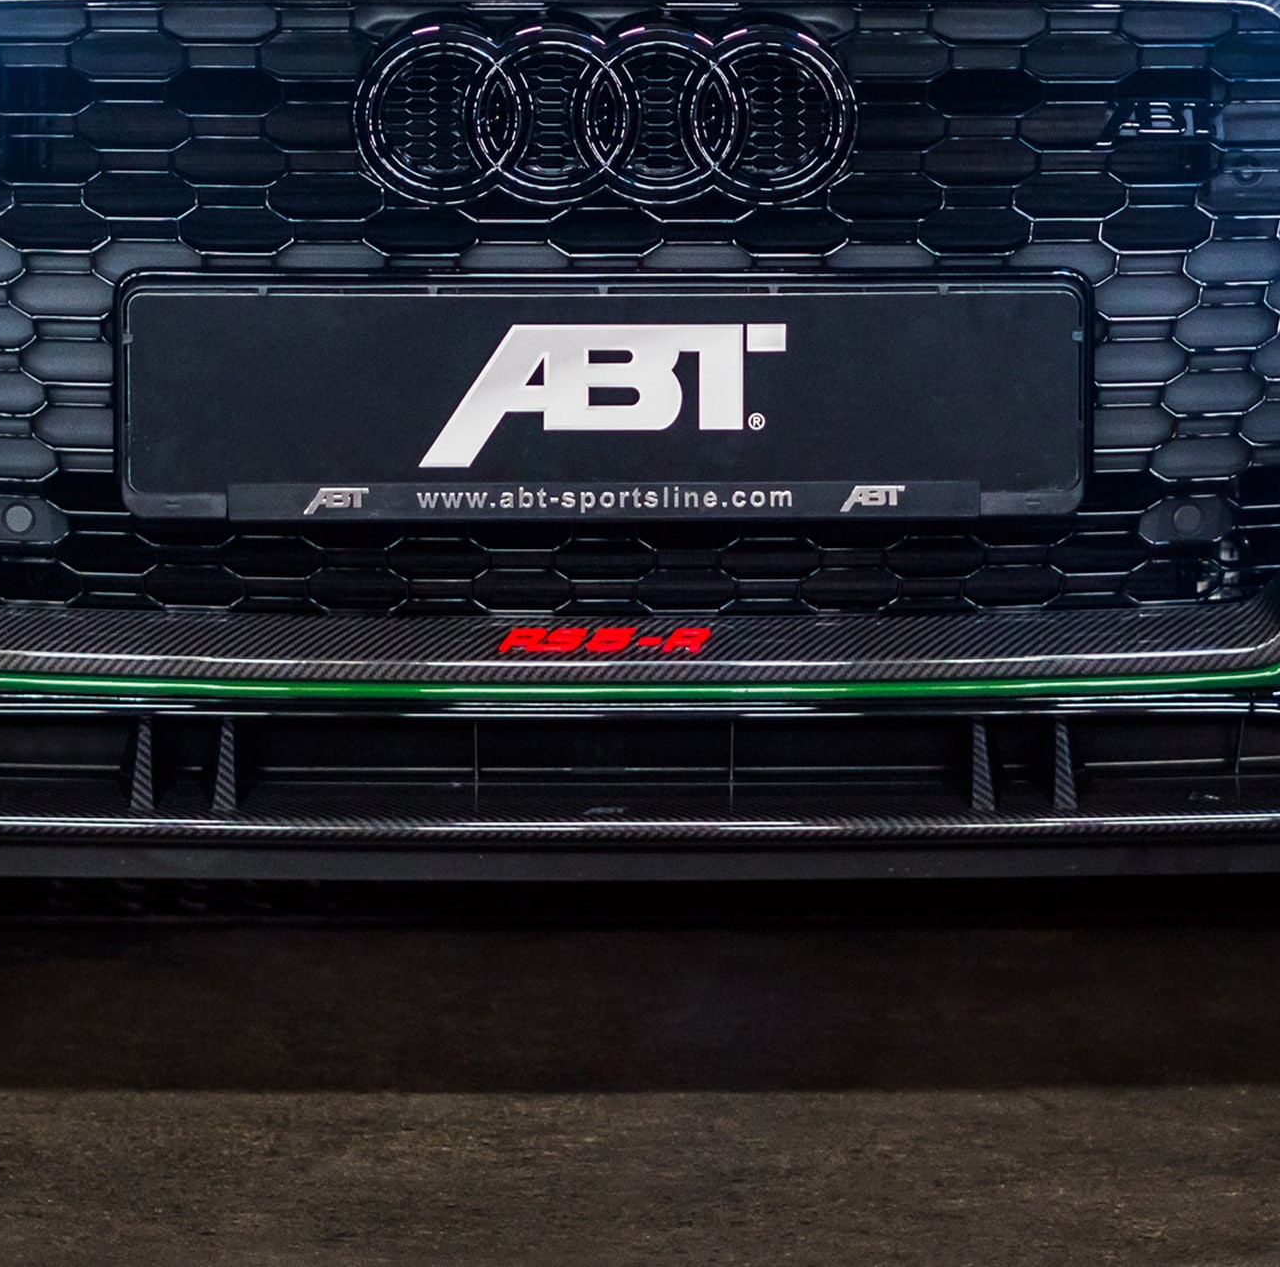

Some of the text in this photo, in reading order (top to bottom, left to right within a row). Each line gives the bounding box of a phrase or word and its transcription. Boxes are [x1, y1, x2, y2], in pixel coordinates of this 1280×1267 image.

[1093, 100, 1224, 148] ABT
[418, 323, 787, 469] ABT
[302, 484, 906, 516] ABT www.abt-sportsline.com ABT
[497, 626, 712, 654] RS5-R
